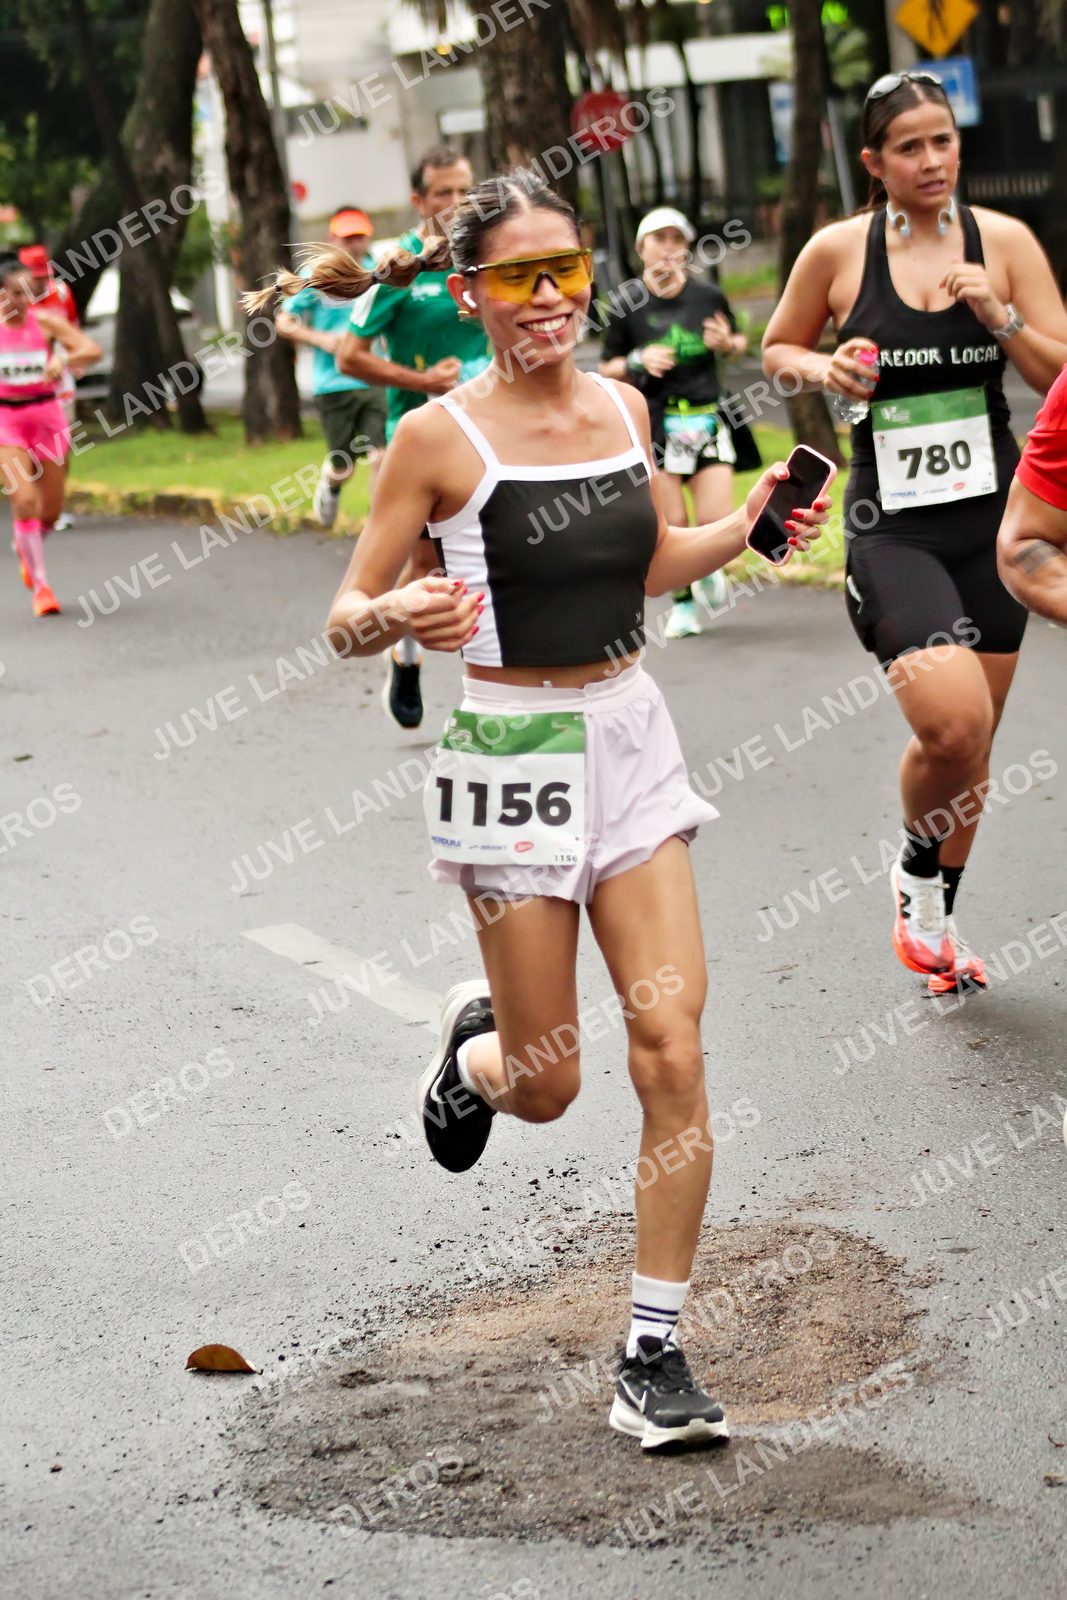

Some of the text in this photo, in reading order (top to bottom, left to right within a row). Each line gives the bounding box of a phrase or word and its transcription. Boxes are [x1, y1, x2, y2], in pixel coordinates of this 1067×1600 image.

[876, 344, 999, 367] REDOR LOCAL
[897, 440, 971, 480] 780
[436, 776, 572, 827] 1156
[553, 854, 578, 862] 1156
